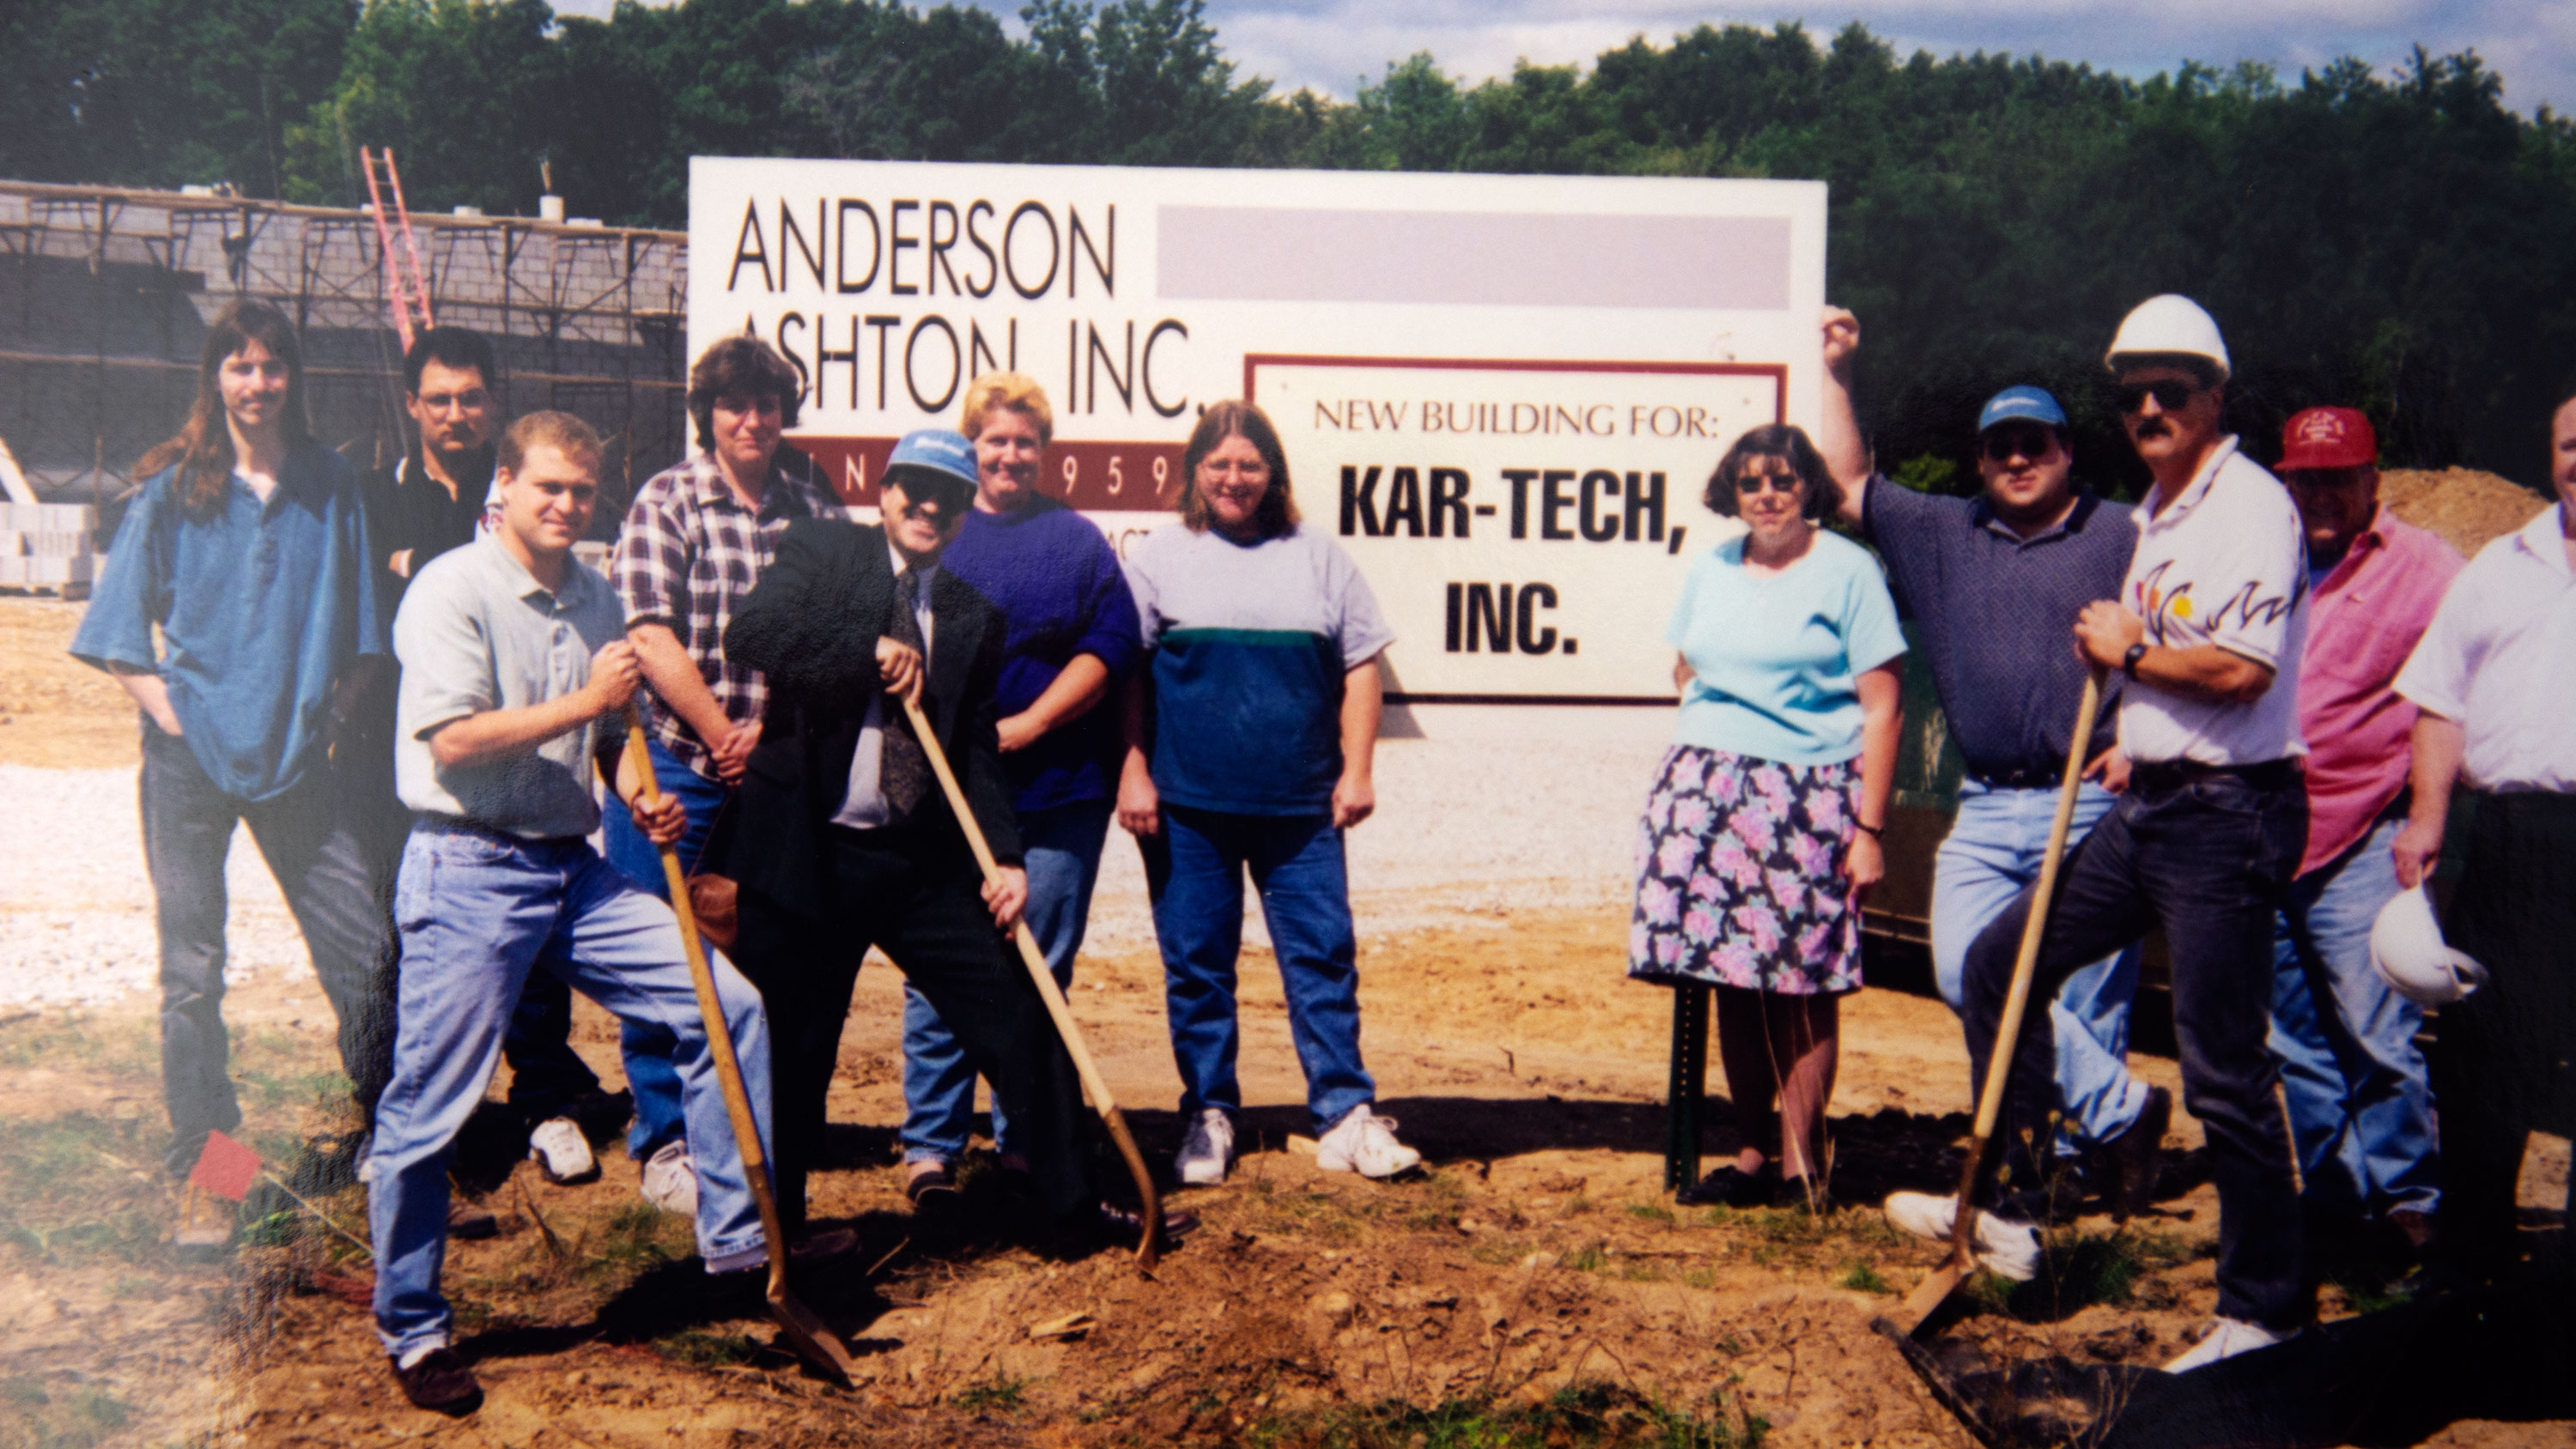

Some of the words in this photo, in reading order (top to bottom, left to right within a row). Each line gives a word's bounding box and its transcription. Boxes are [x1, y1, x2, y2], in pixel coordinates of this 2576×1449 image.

[727, 195, 1116, 301] ANDERSON
[742, 311, 1018, 415] SHTON
[1068, 318, 1206, 419] INC.
[1315, 399, 1408, 432] NEW
[1422, 401, 1616, 436] BUILDING
[1631, 405, 1719, 440] FOR:
[1062, 455, 1169, 494] 959
[1339, 465, 1686, 556] KAR-TECH,
[1445, 582, 1578, 657] INC.
